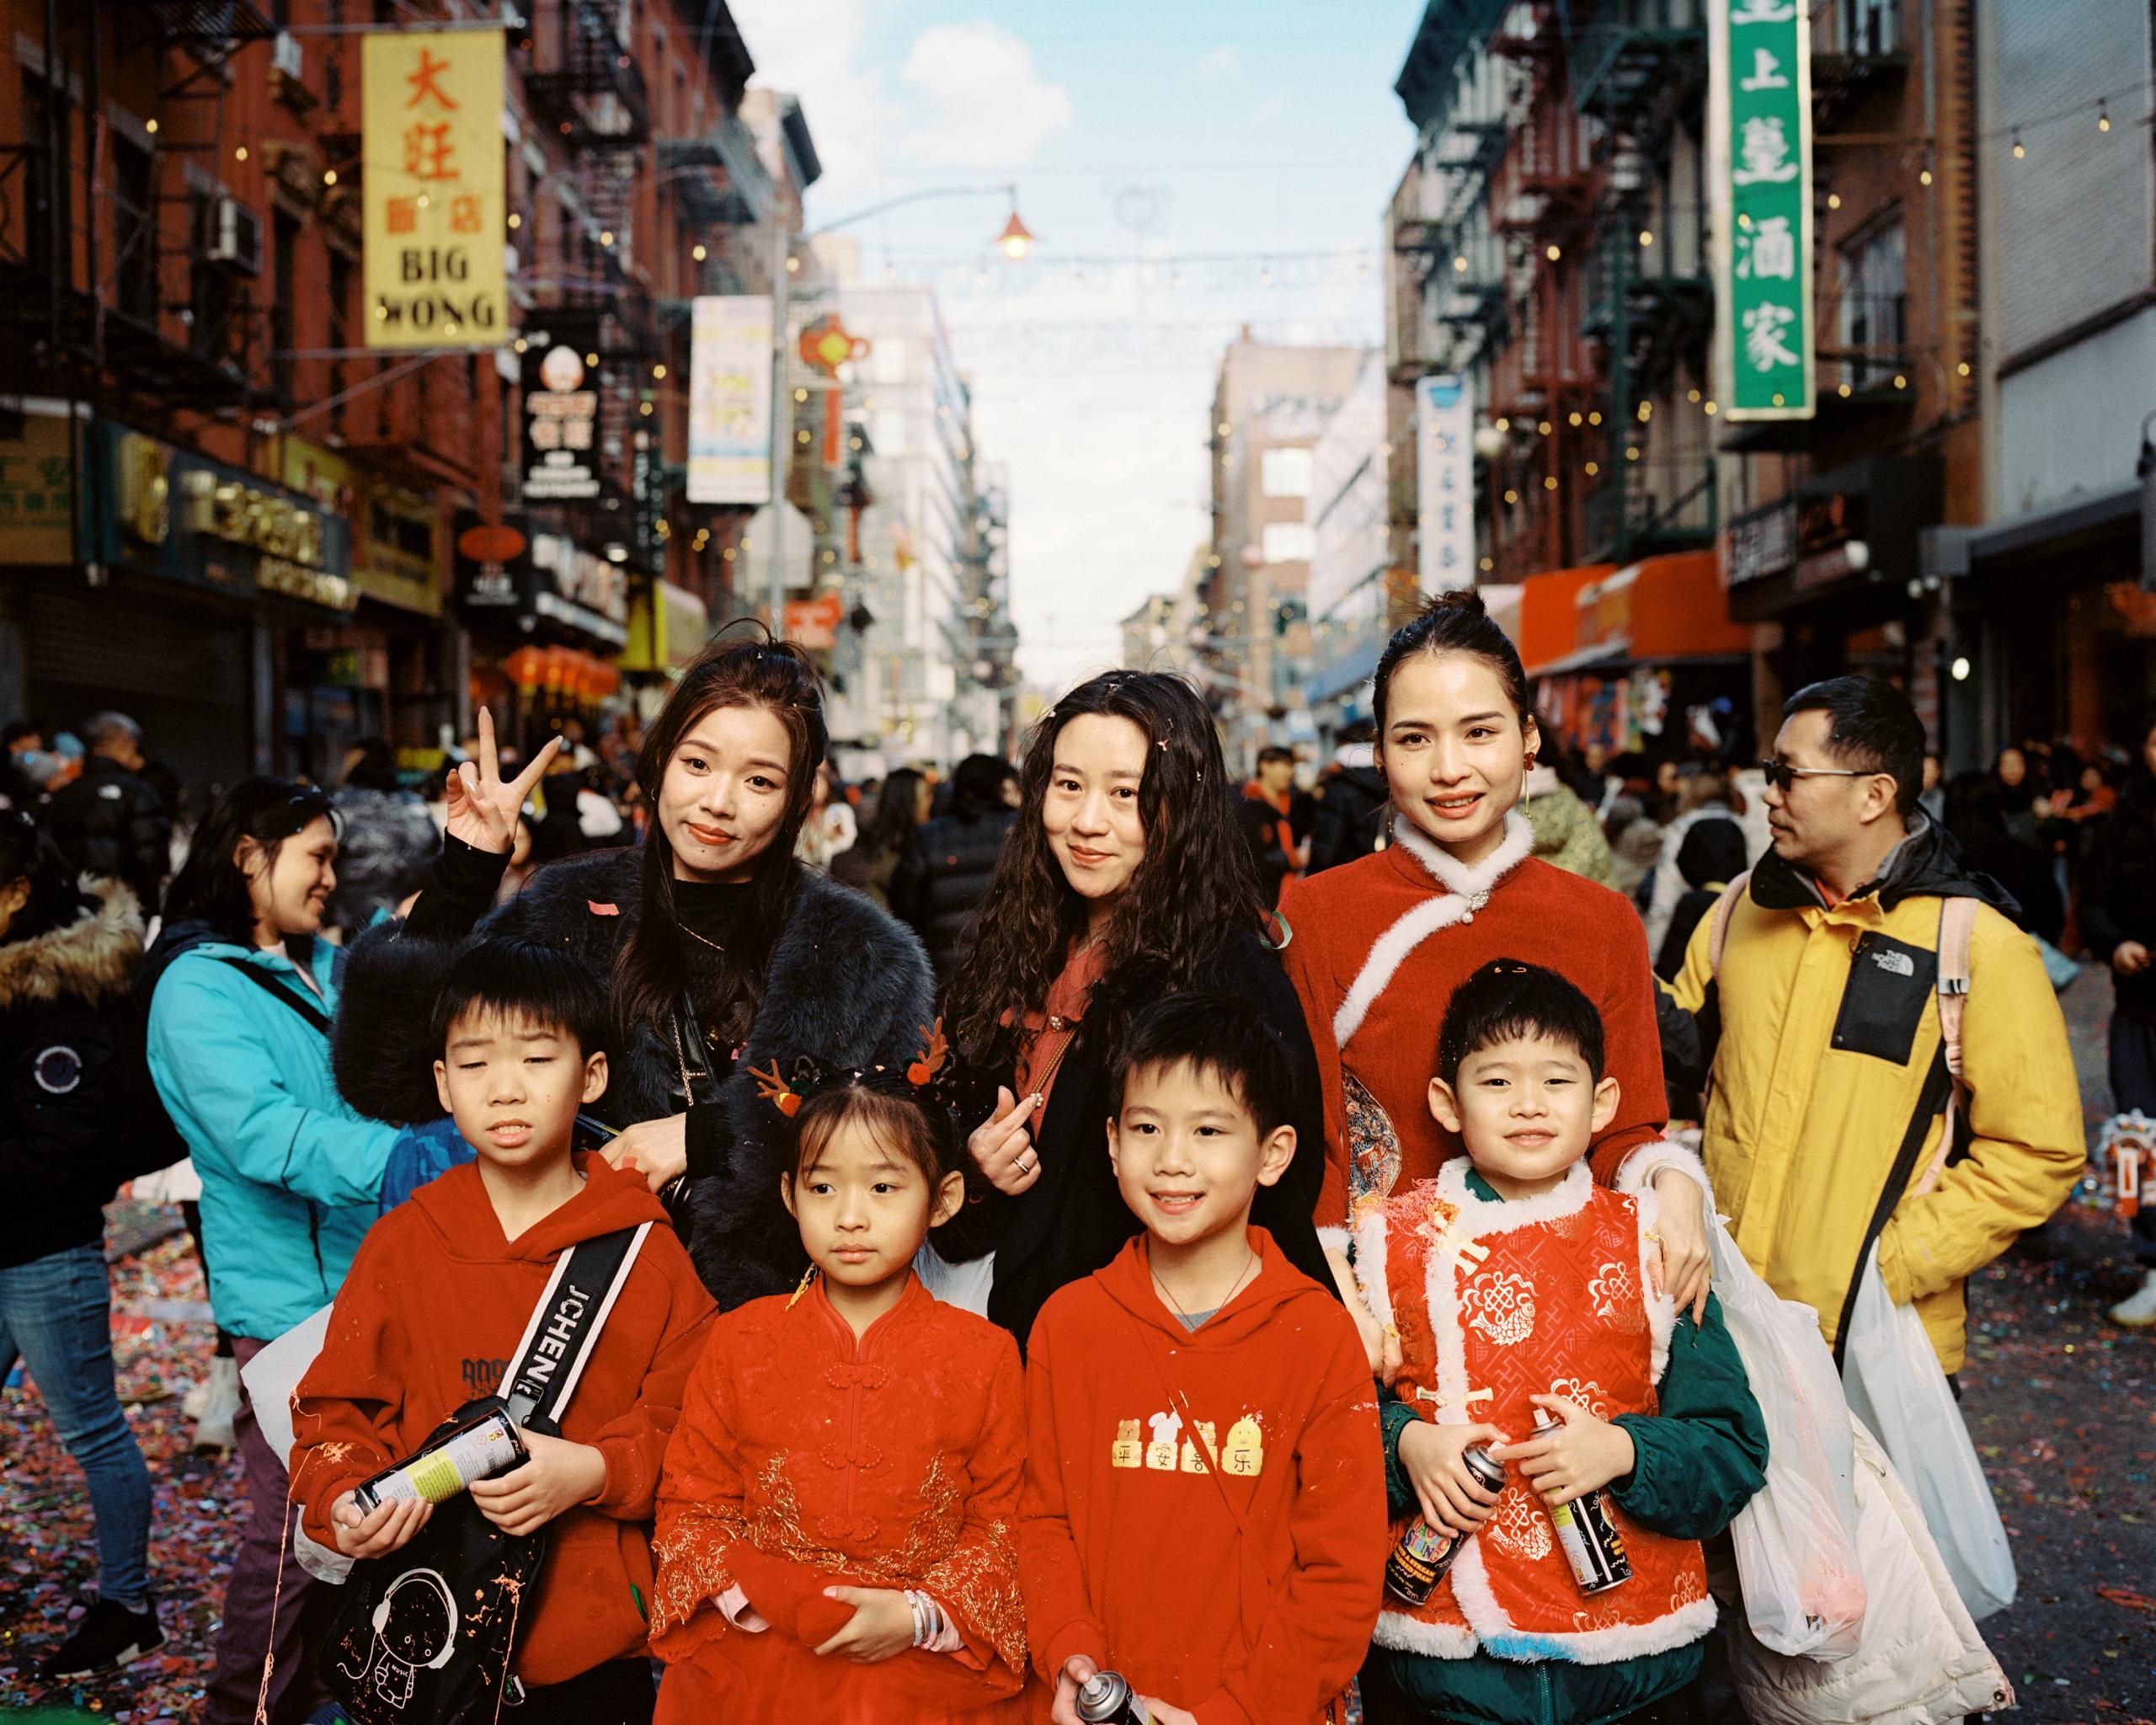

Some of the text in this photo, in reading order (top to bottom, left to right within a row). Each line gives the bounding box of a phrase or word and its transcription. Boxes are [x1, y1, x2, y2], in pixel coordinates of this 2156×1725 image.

[402, 248, 469, 283] BIG
[377, 294, 495, 329] WONG
[1871, 952, 1903, 968] NORTH
[1403, 1528, 1441, 1564] STRING
[392, 1664, 409, 1677] MUSIC
